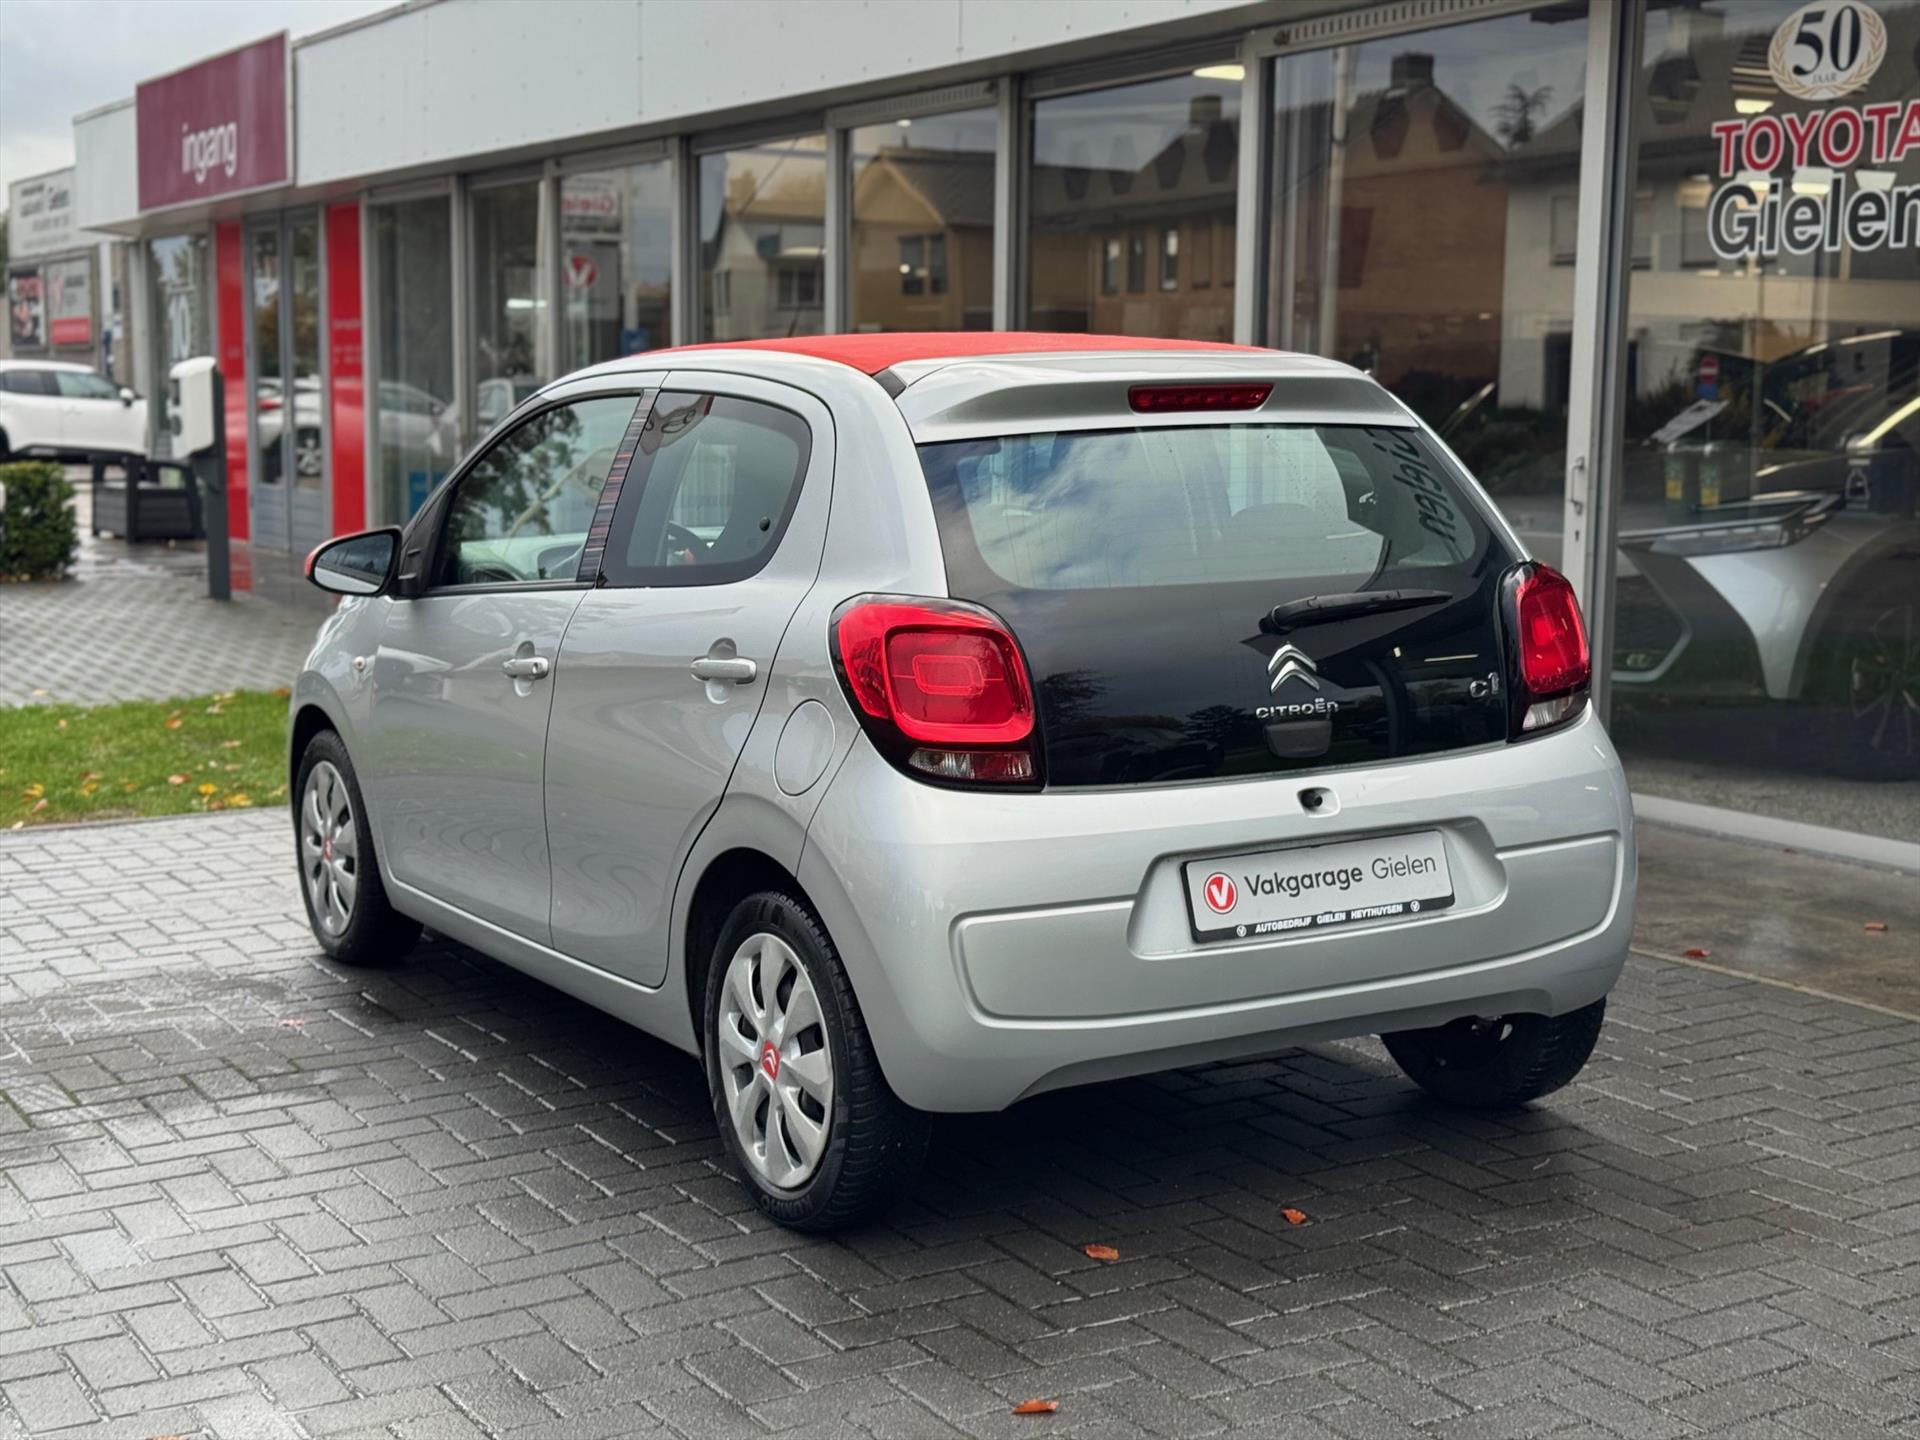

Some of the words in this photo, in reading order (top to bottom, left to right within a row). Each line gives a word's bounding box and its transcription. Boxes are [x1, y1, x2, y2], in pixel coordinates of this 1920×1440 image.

[1792, 5, 1861, 77] 50
[181, 122, 237, 184] ingang
[1711, 100, 1920, 178] TOYOTA
[1708, 172, 1920, 259] Gielen
[1244, 866, 1363, 898] Vakgarage
[1371, 855, 1437, 880] Gielen
[1255, 916, 1312, 934] AUTOBEDRIJF
[1316, 911, 1346, 925] GIELEN
[1350, 903, 1403, 920] HEYTHUYSEN
